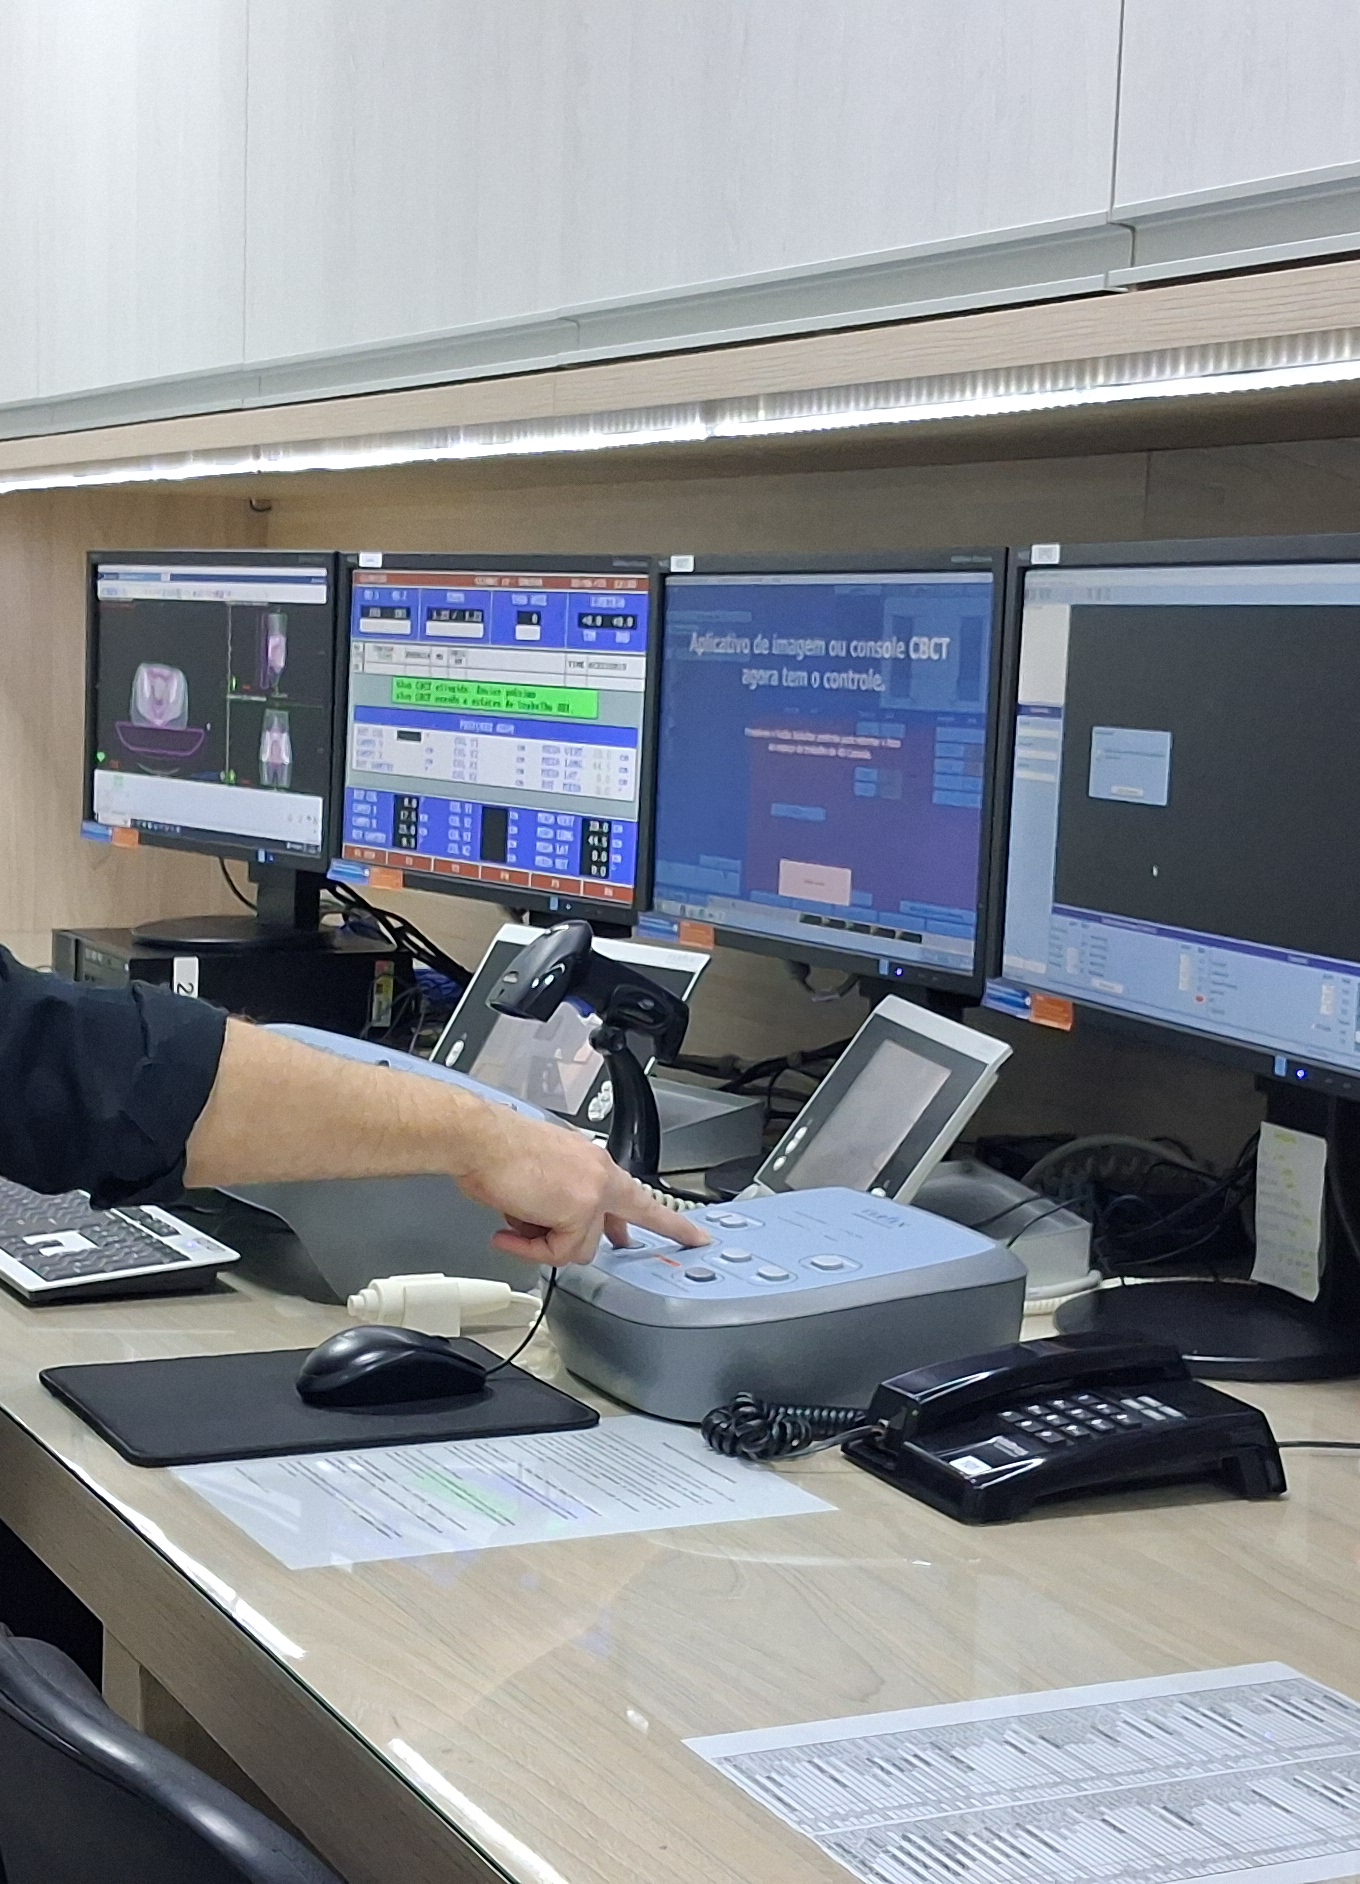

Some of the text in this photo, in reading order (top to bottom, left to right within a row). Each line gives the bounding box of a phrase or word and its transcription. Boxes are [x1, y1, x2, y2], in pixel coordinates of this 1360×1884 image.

[753, 633, 769, 655] de
[828, 639, 846, 657] ou
[849, 635, 905, 659] console
[908, 636, 951, 660] CBCT
[810, 671, 820, 689] o
